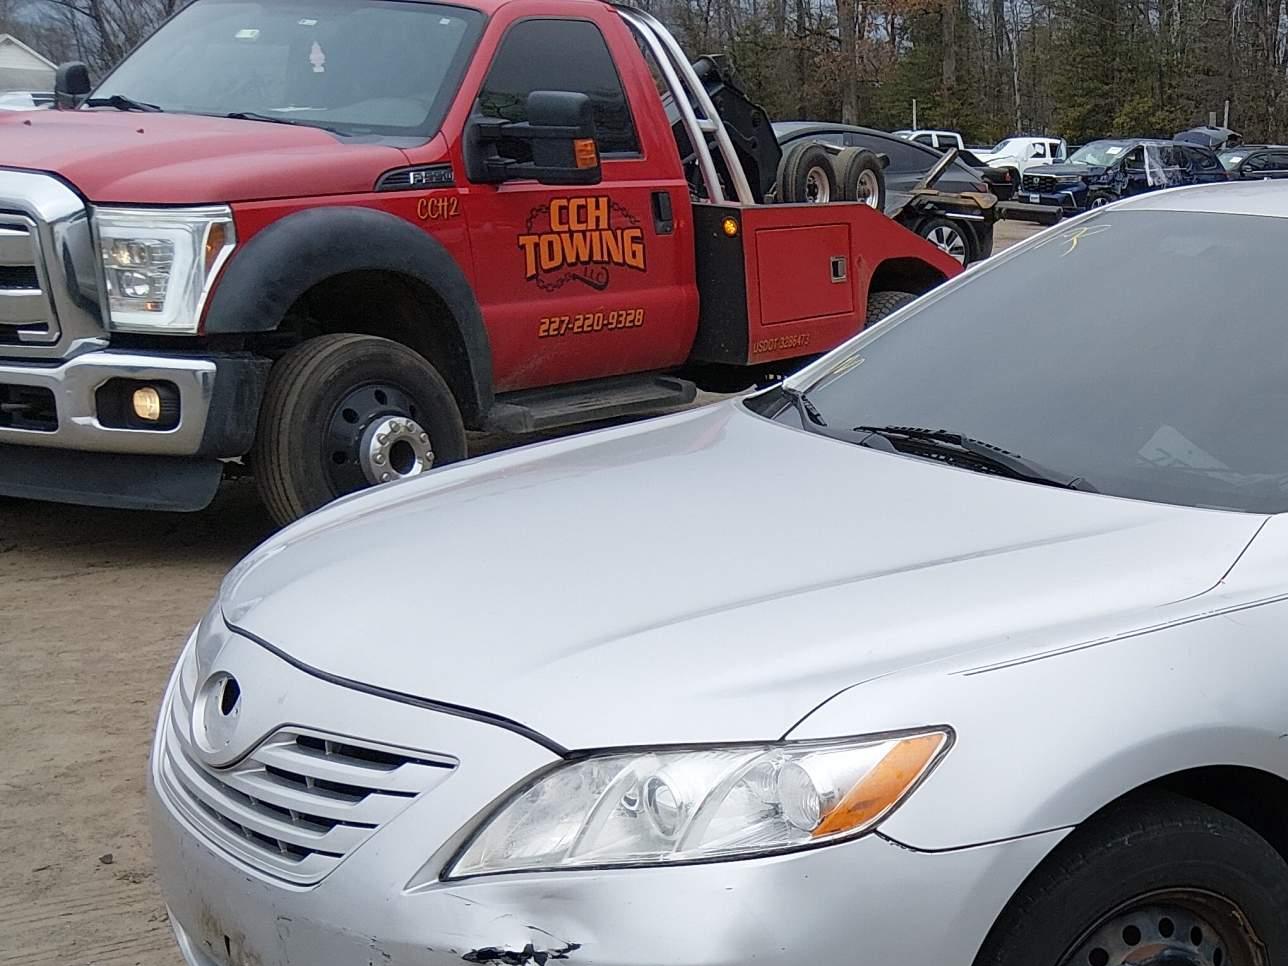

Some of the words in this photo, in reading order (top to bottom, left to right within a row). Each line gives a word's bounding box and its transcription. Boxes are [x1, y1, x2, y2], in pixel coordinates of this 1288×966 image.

[417, 196, 460, 220] CCH2
[549, 195, 611, 232] CCH
[517, 228, 647, 281] TOWING
[538, 308, 644, 337] 227-220-9328
